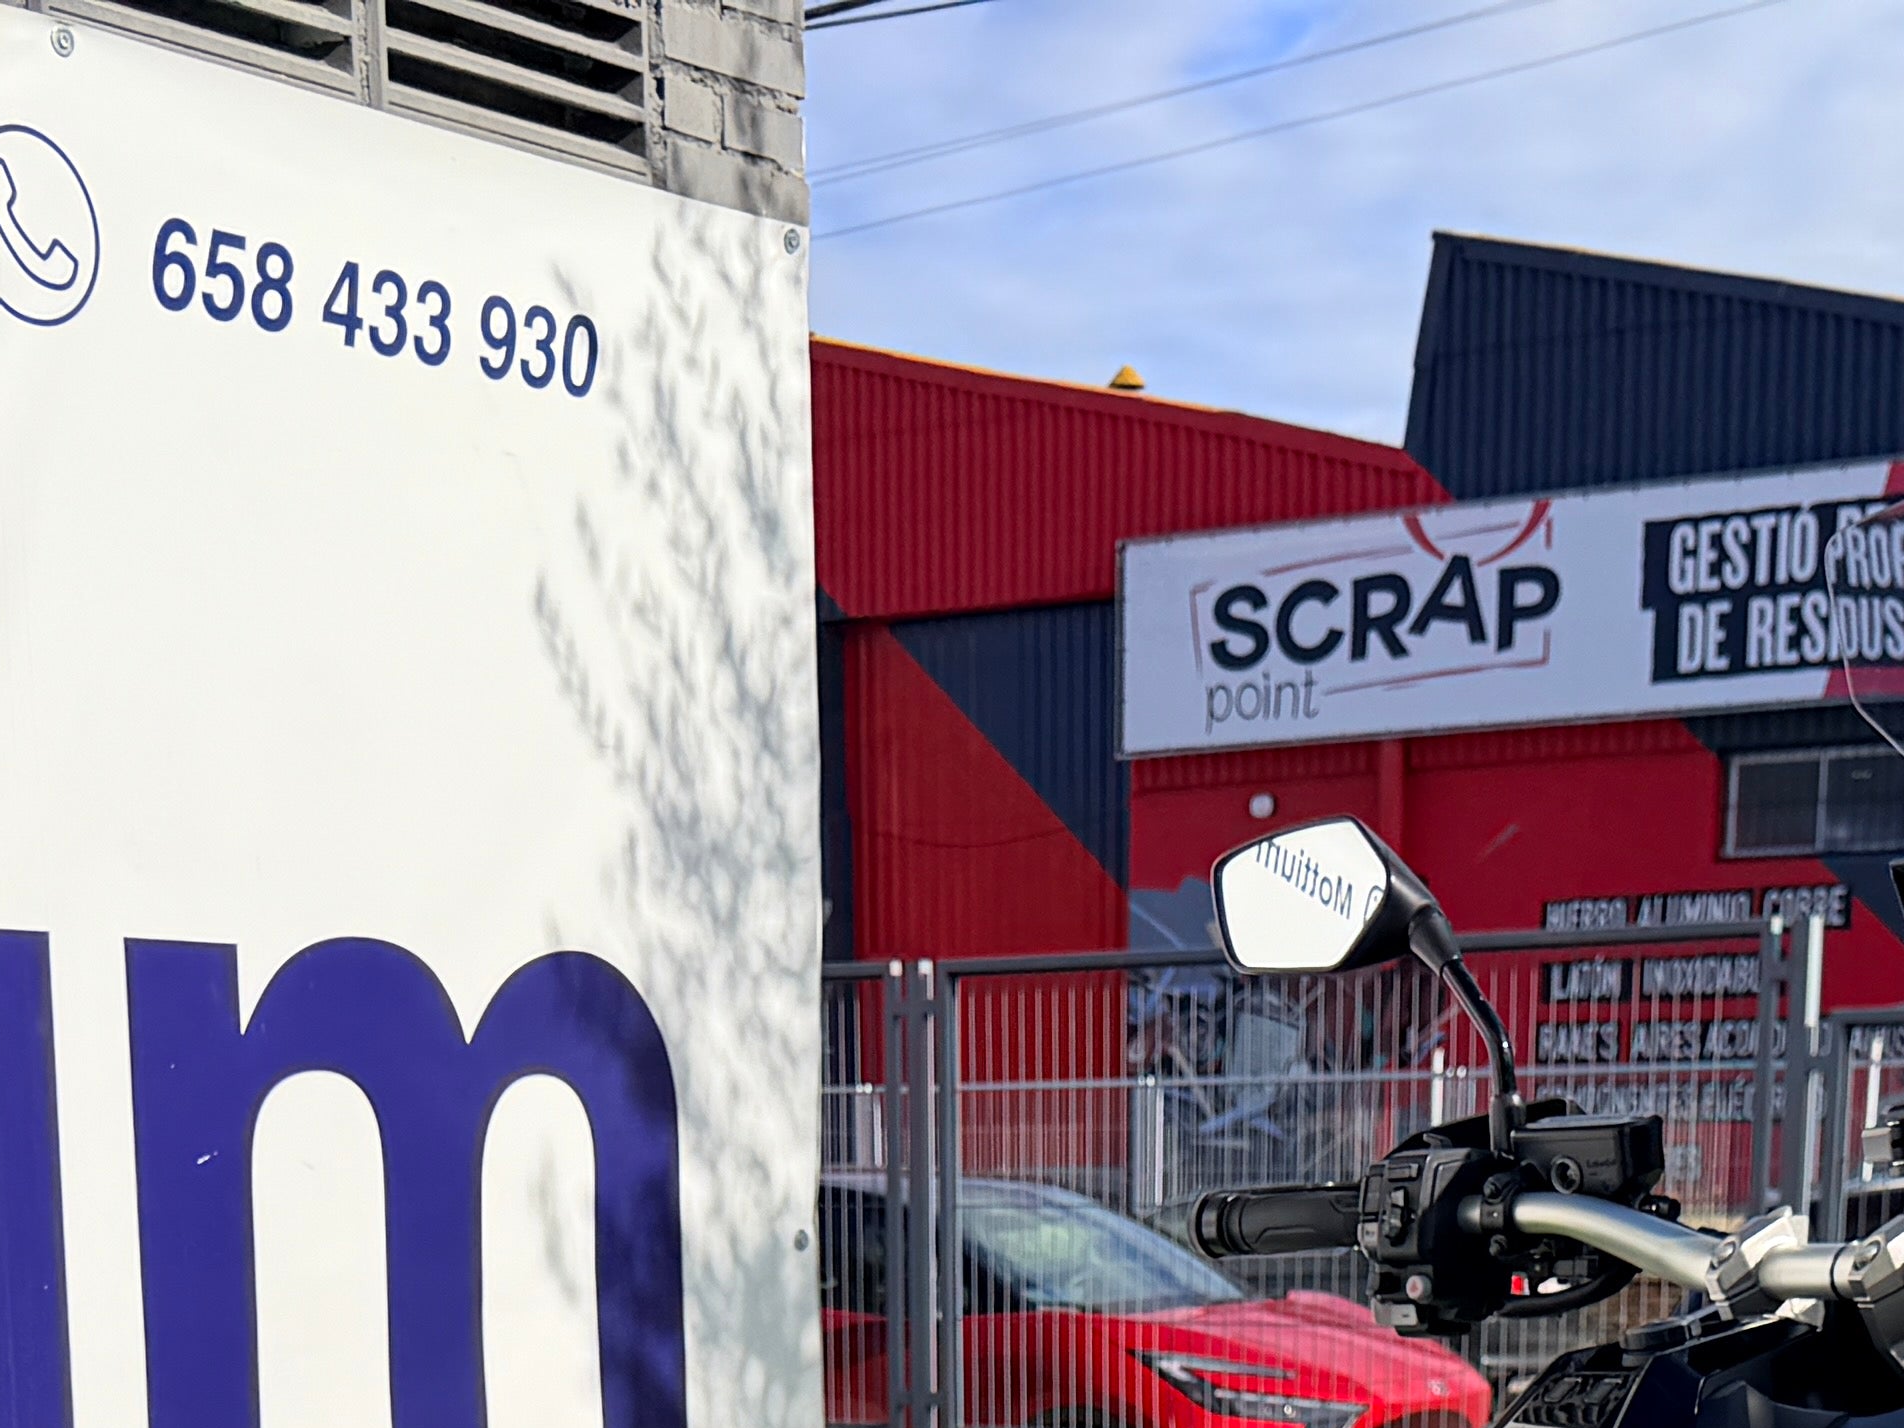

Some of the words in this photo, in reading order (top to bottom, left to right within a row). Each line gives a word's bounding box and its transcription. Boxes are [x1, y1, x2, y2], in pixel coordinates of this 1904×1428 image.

[151, 217, 295, 333] 658
[321, 260, 453, 367] 433
[478, 295, 600, 398] 930
[1668, 500, 1818, 595] GESTIÓ
[1209, 554, 1561, 672] SCRAP
[1676, 600, 1732, 675] DE
[1205, 669, 1321, 735] point
